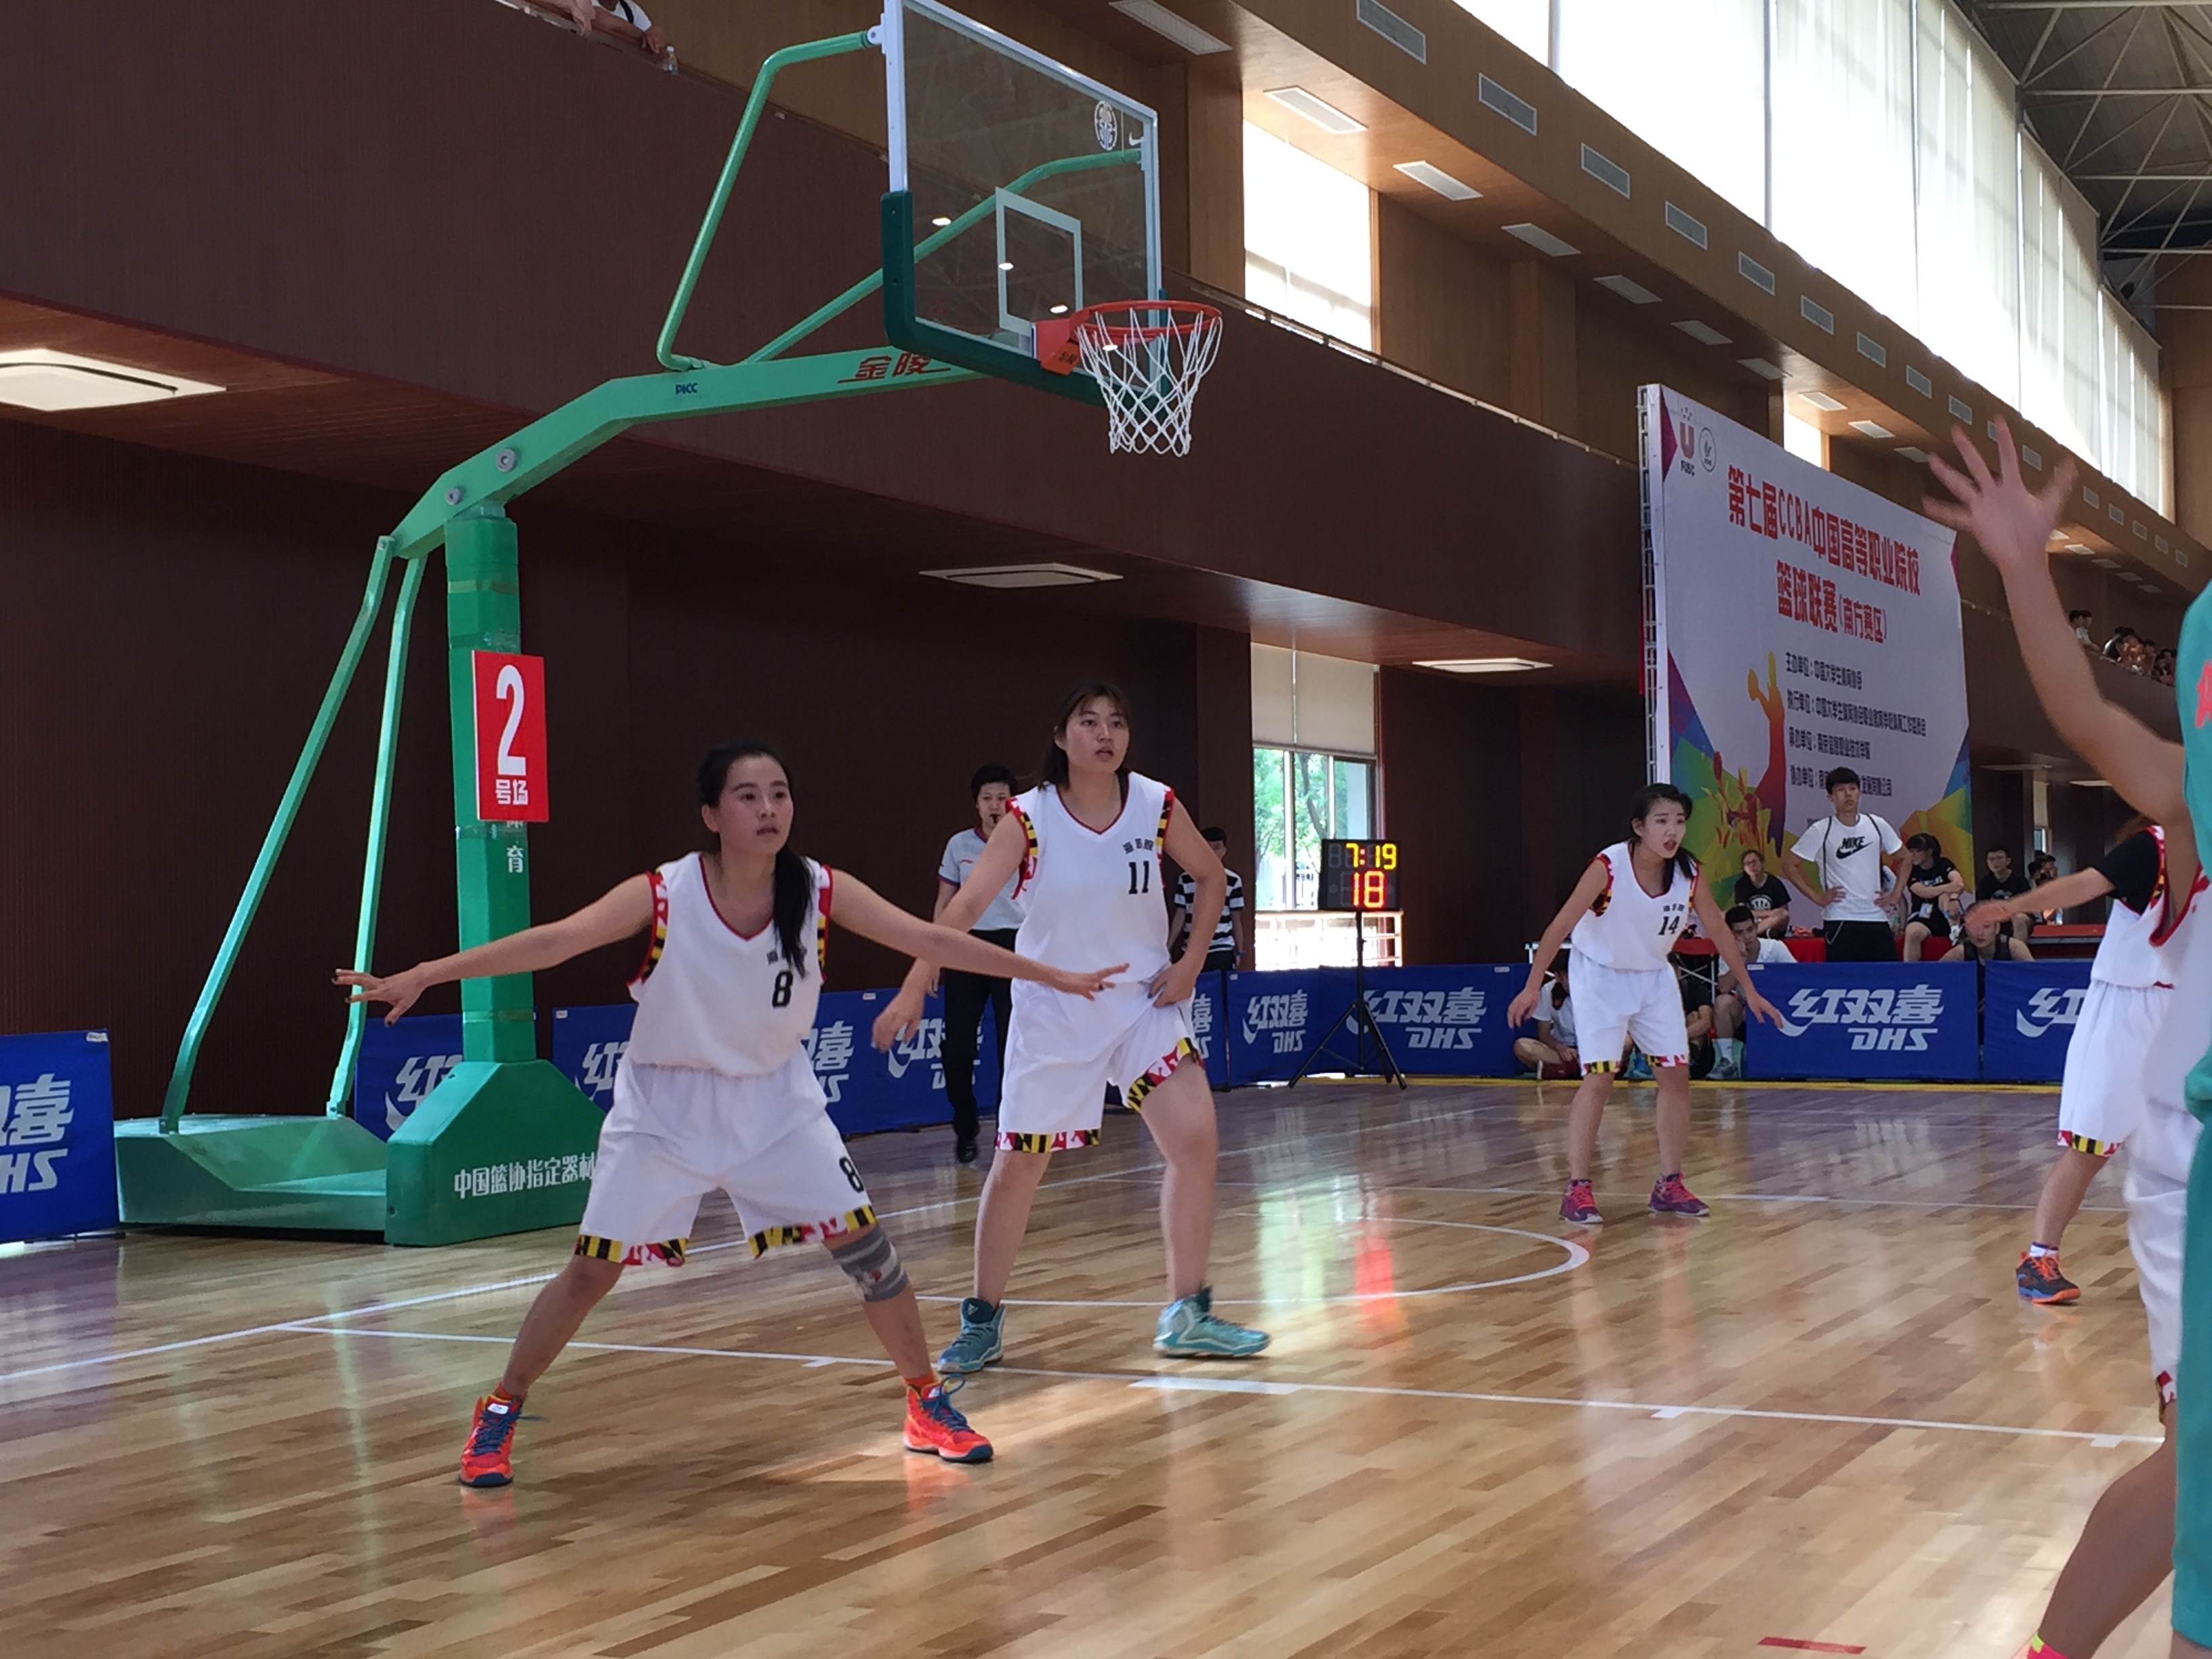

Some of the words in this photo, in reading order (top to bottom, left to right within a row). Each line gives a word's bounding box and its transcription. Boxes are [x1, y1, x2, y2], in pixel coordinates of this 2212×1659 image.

[676, 383, 698, 394] PICC
[1729, 464, 1921, 596] 第七届CCBA中国高等职业院校
[495, 665, 526, 776] 2
[495, 779, 529, 805] 号场
[1346, 843, 1397, 869] 7:19
[1841, 836, 1865, 849] NIKE
[1128, 860, 1149, 895] 11
[1353, 871, 1385, 907] 18
[1658, 916, 1680, 935] 14
[773, 971, 794, 1007] 8
[1363, 987, 1487, 1024] 红双喜
[1788, 984, 1944, 1024] 红双喜
[1247, 989, 1309, 1029] 红双喜
[1271, 1029, 1307, 1054] DHS
[1405, 1027, 1482, 1049] DHS
[1847, 1028, 1938, 1050] DHS
[0, 1148, 68, 1194] HS
[455, 1152, 596, 1199] 中国篮协指定器材
[839, 1157, 864, 1193] 8
